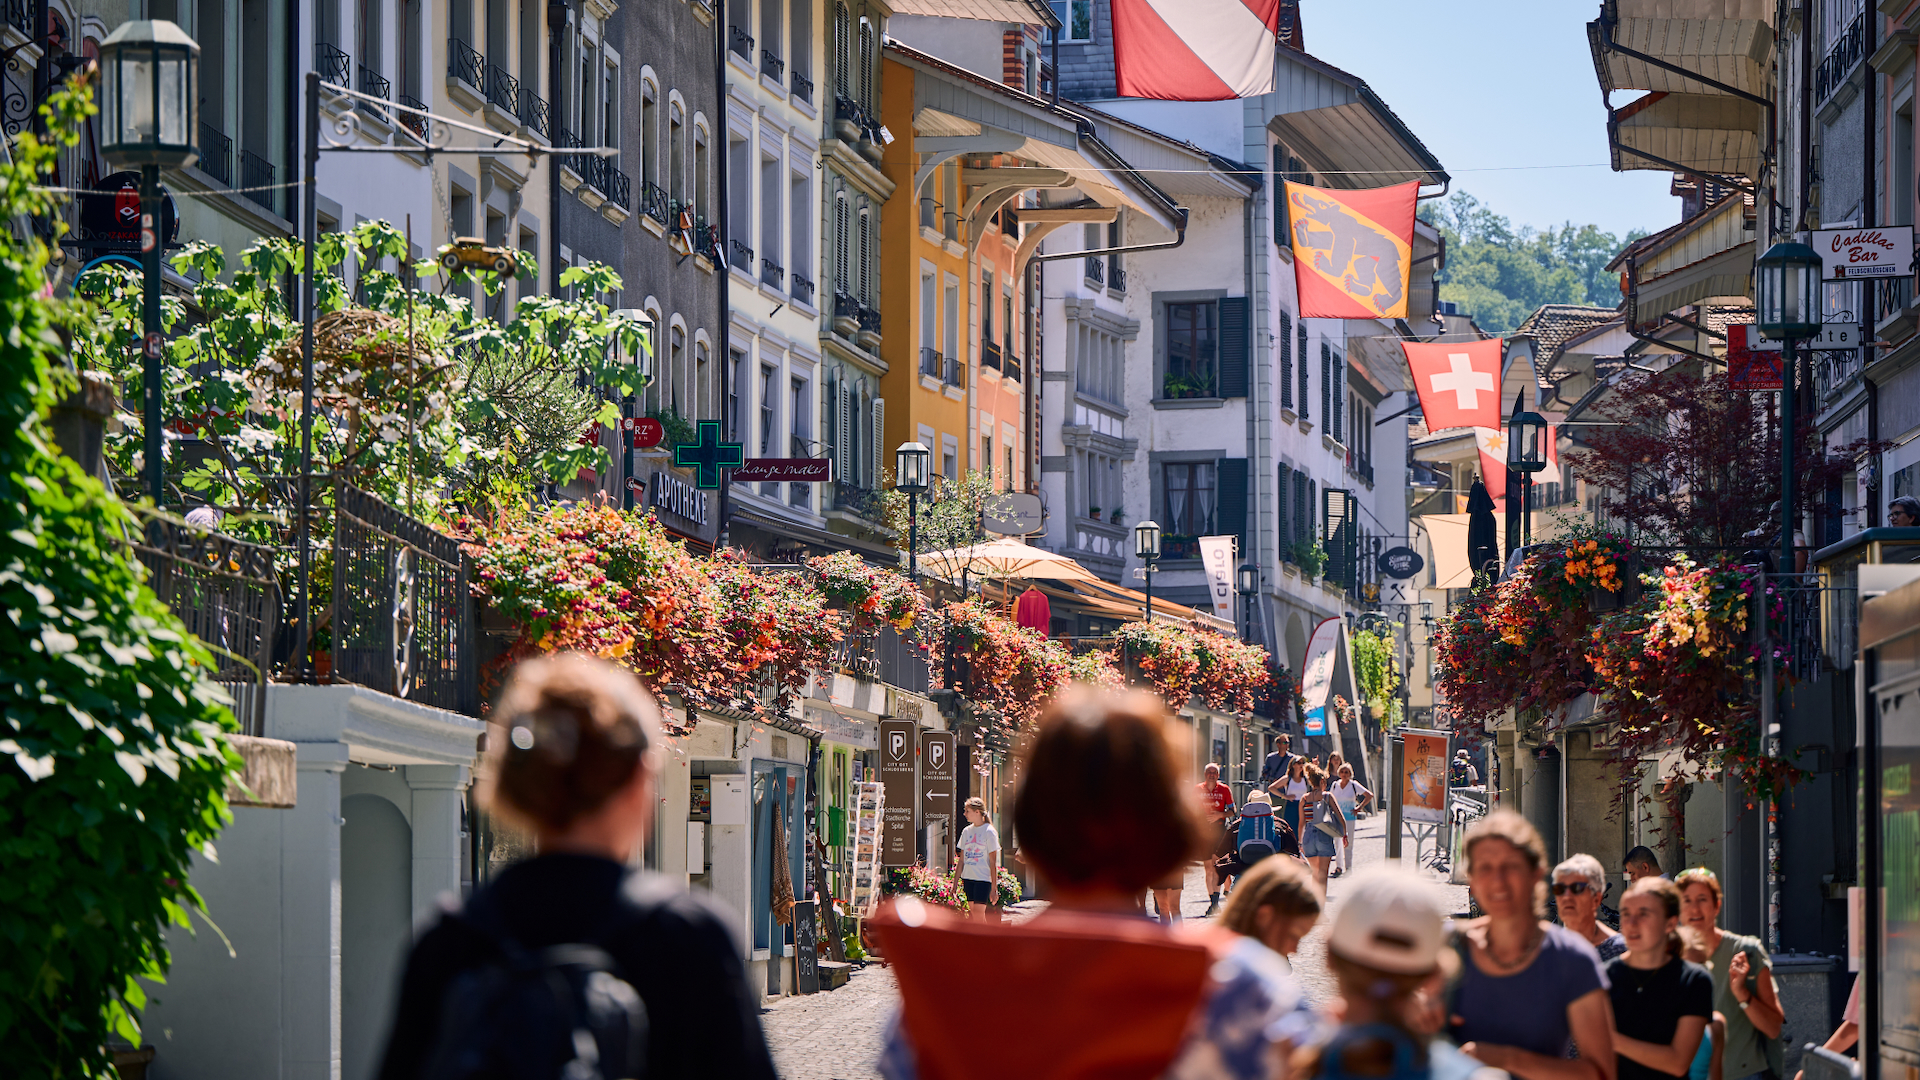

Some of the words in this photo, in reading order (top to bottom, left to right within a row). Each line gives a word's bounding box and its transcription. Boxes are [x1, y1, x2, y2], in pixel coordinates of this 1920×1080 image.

[1831, 231, 1895, 252] Cadillac
[1848, 246, 1879, 263] Bar
[1848, 266, 1896, 275] FELDSCHLÖSSCHEN
[783, 464, 827, 477] maker
[657, 471, 708, 526] APOTHEKE
[1313, 650, 1327, 687] Kiosk
[892, 734, 904, 755] P
[932, 745, 943, 764] P
[884, 806, 911, 815] Schlossberg
[885, 814, 911, 822] Stadtkirche
[891, 822, 904, 830] Spital
